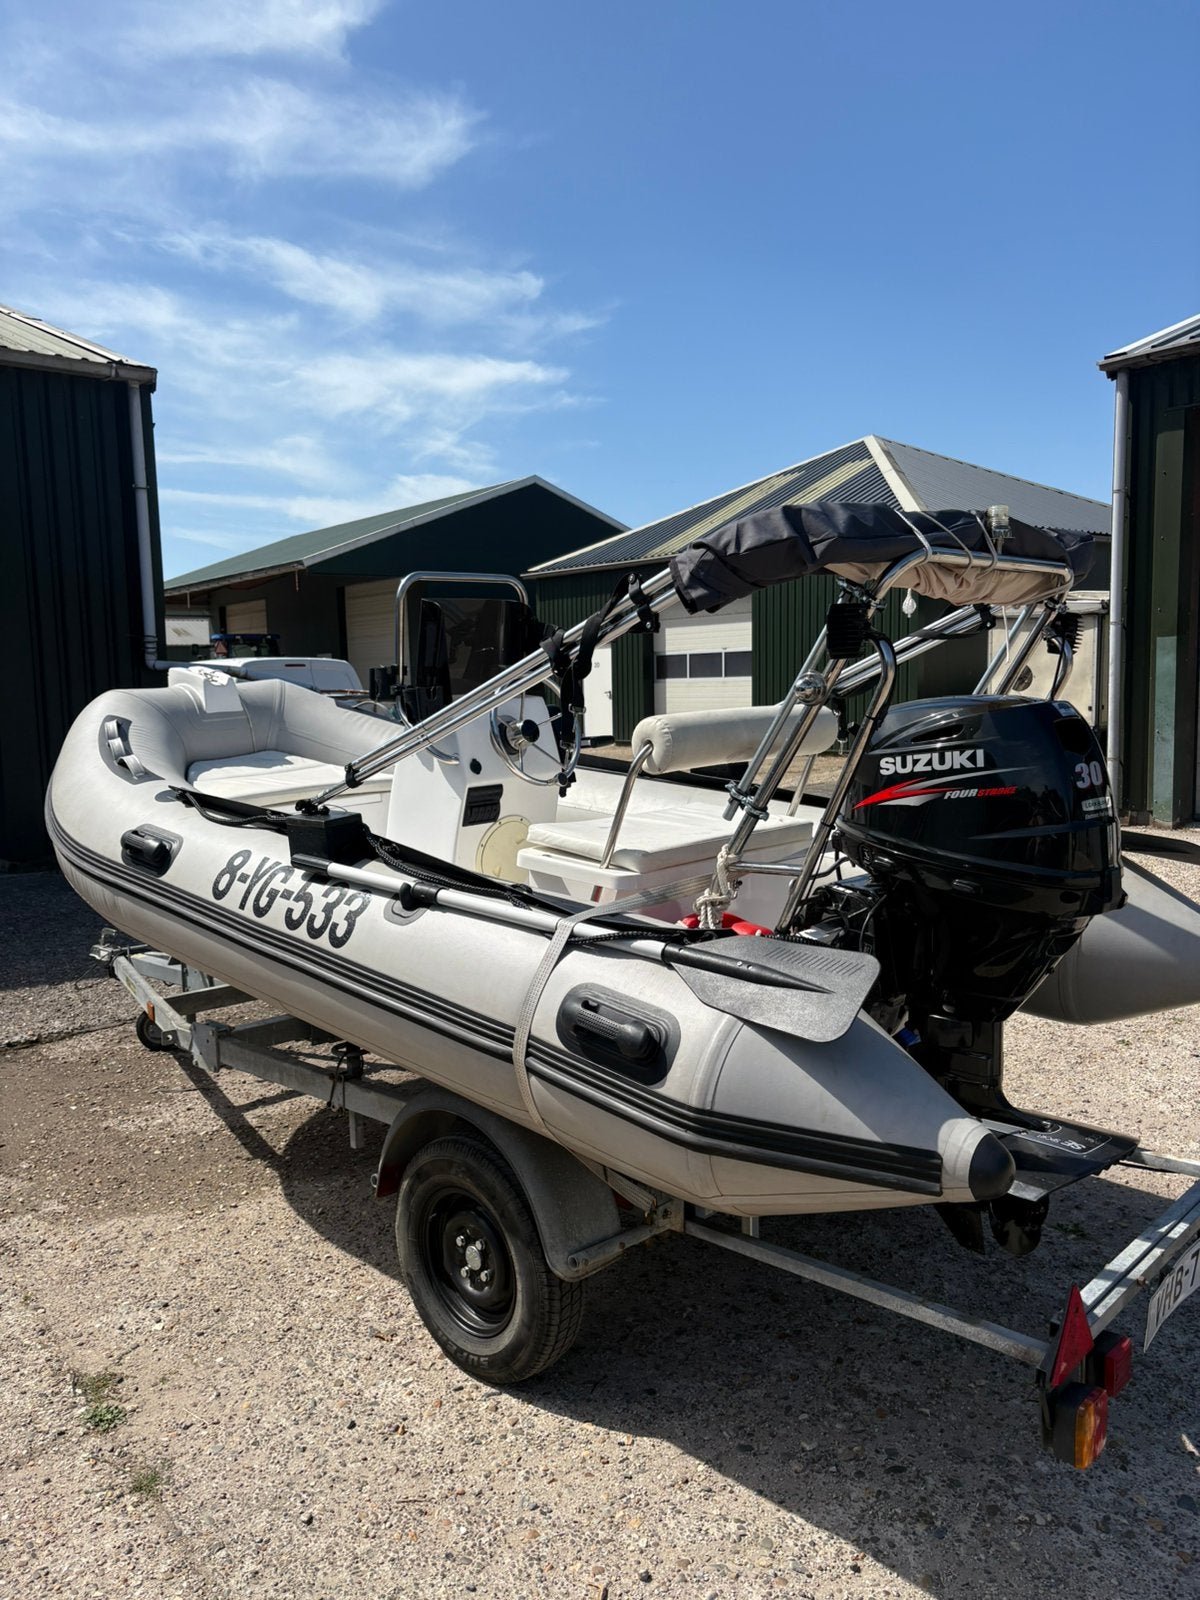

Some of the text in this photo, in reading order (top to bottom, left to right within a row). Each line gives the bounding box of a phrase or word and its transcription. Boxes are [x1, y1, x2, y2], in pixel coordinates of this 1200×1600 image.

[879, 749, 985, 776] SUZUKI
[1074, 761, 1103, 789] 30
[212, 849, 373, 949] 8-YG-533
